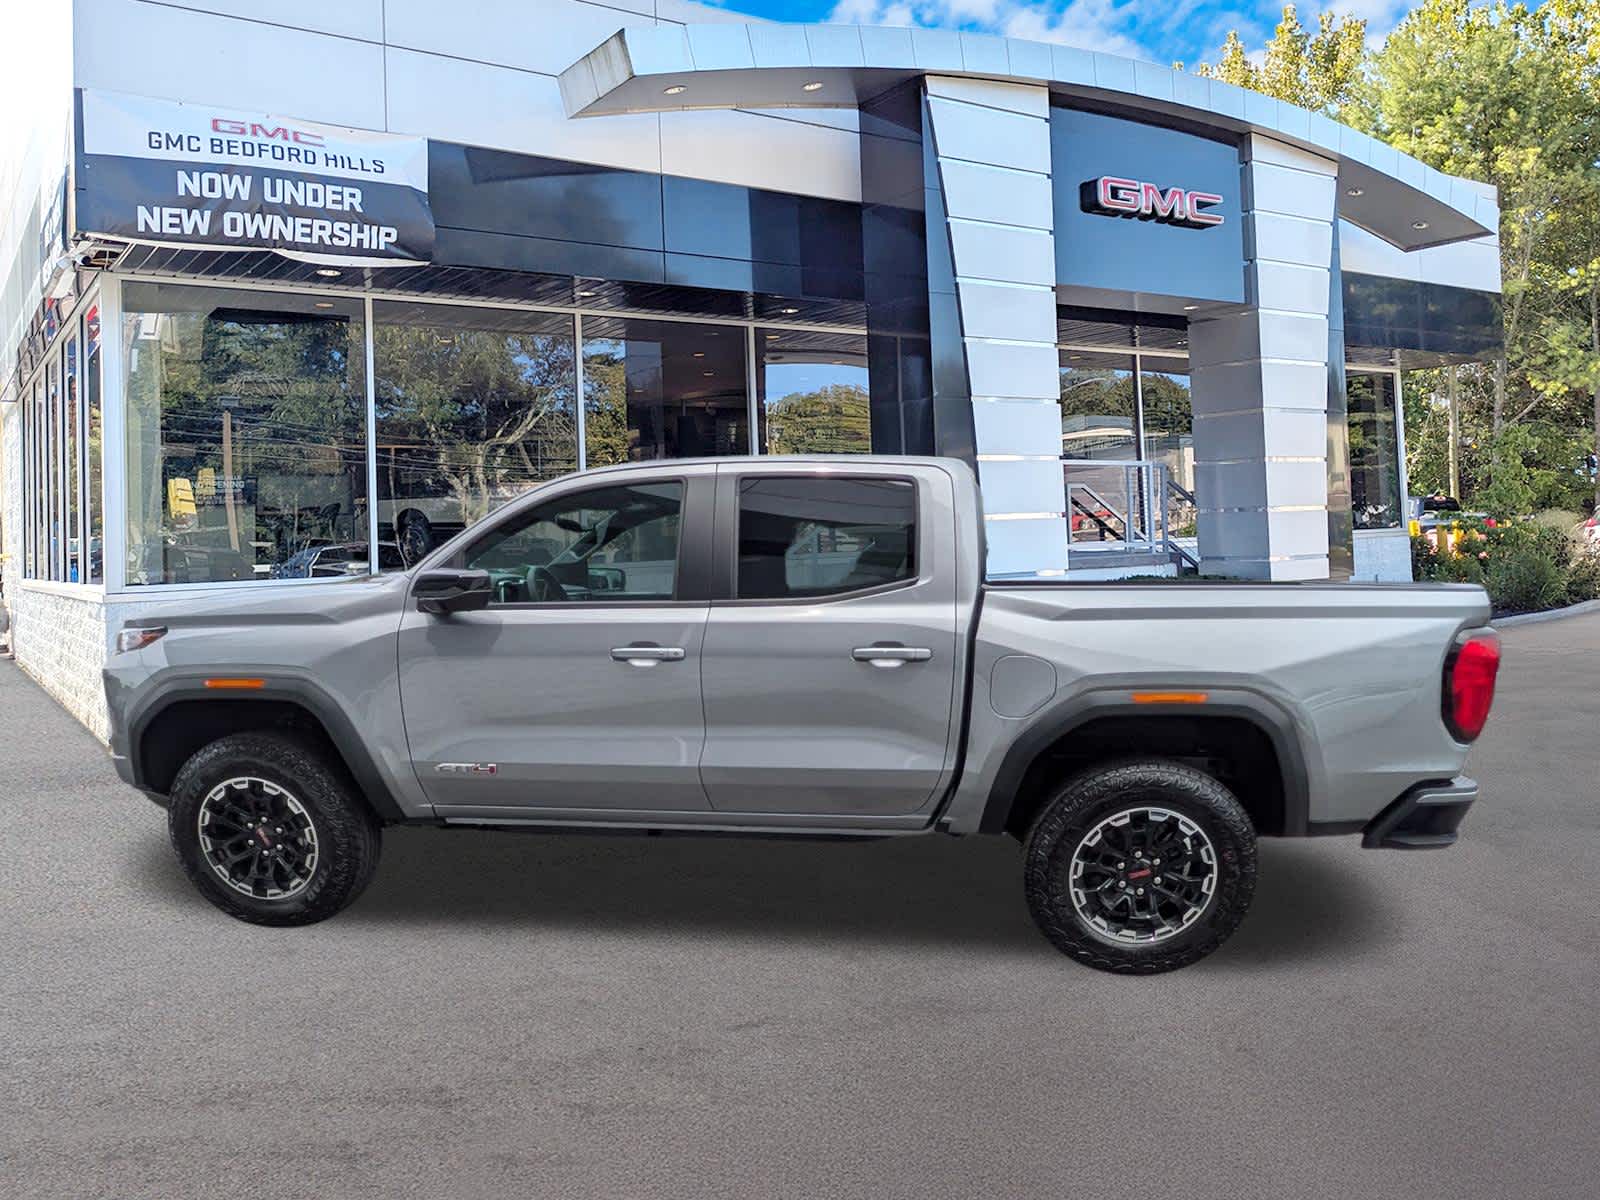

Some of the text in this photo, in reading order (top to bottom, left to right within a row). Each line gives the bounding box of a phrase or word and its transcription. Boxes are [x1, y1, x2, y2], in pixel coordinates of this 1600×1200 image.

[148, 131, 385, 174] GMC BEDFORD HILLS
[211, 118, 326, 148] GMC
[177, 170, 364, 213] NOW UNDER
[1097, 175, 1225, 225] GMC
[136, 205, 398, 250] NEW OWNERSHIP
